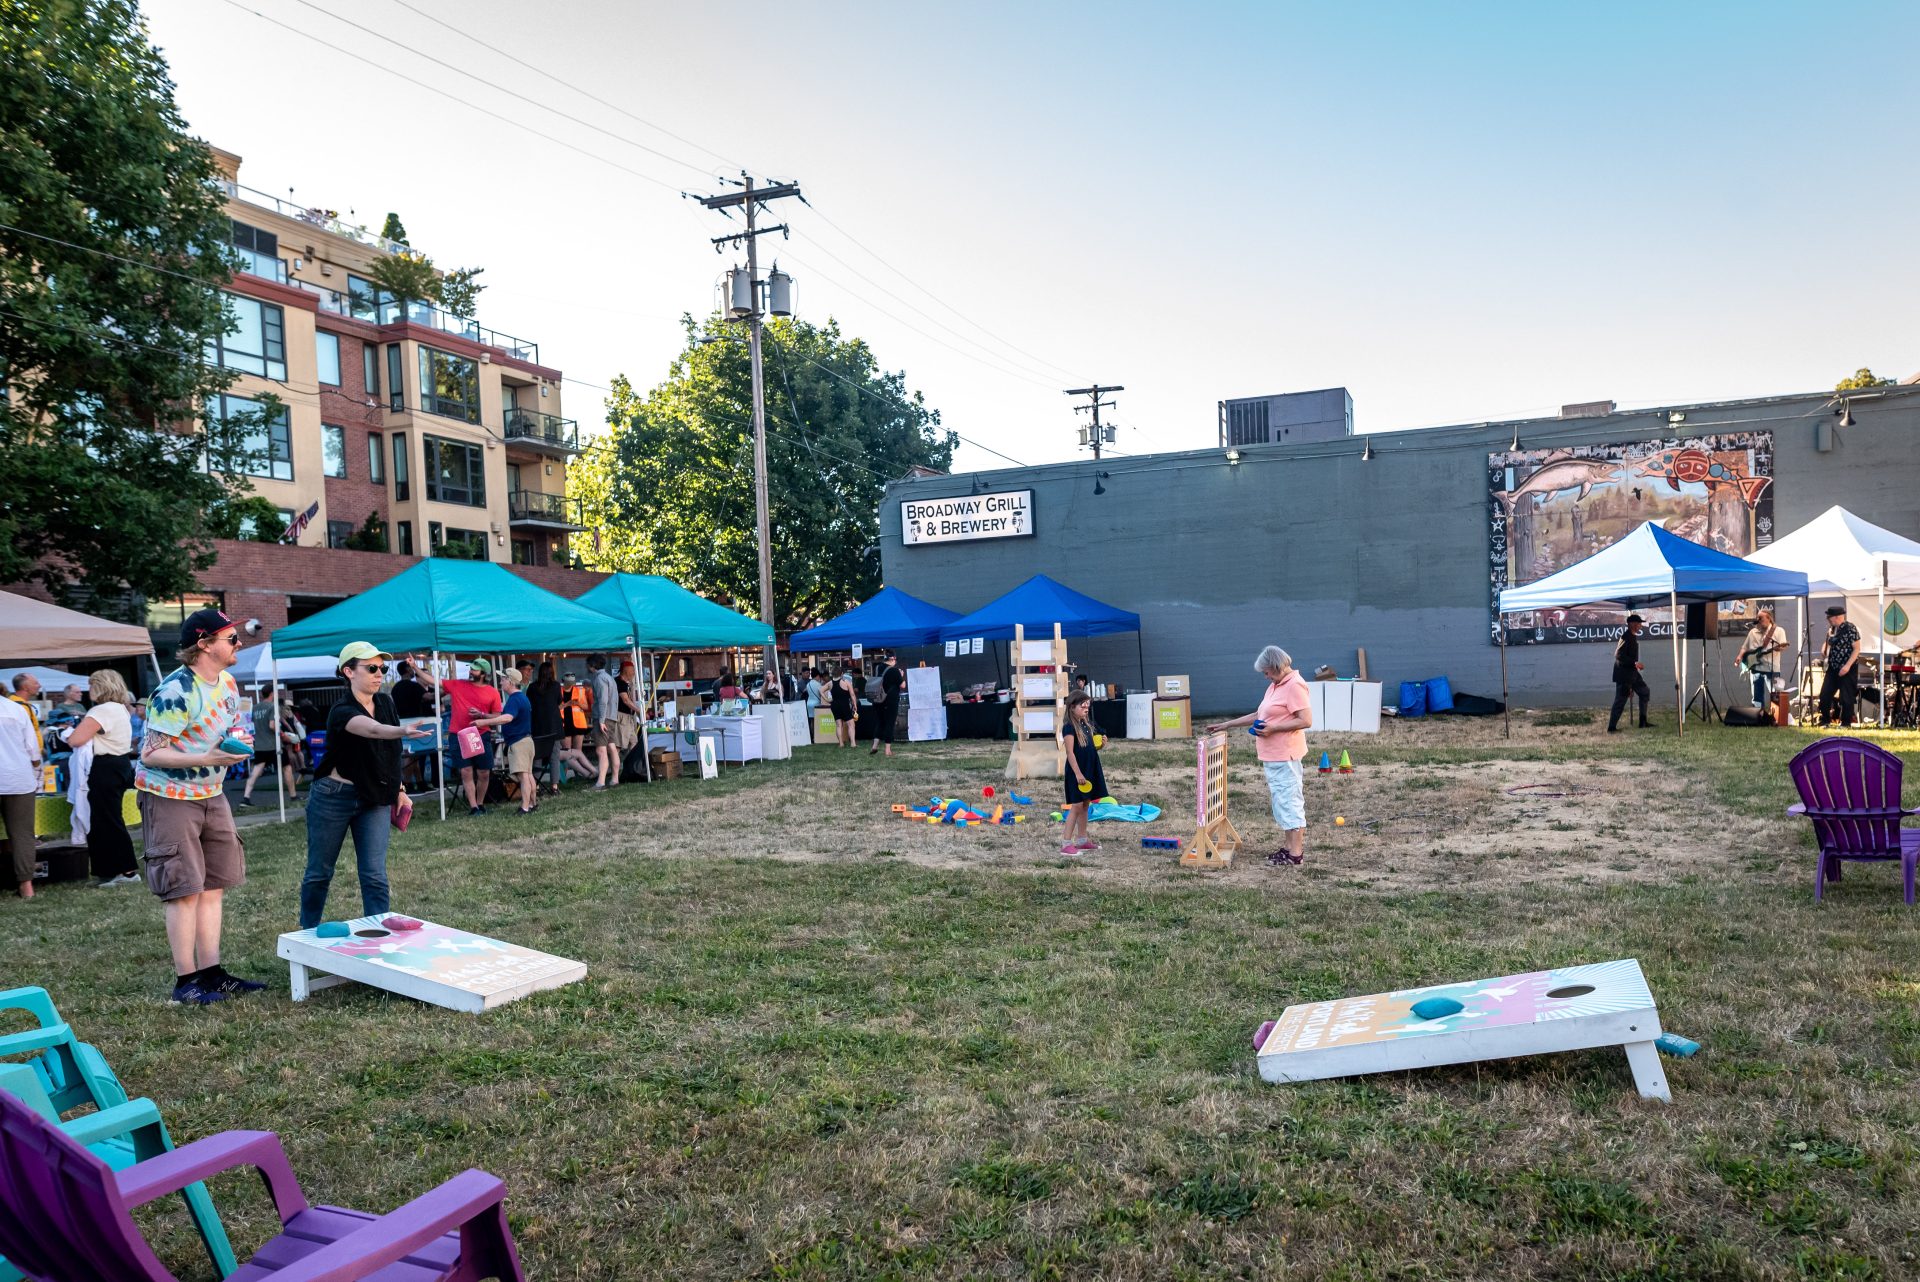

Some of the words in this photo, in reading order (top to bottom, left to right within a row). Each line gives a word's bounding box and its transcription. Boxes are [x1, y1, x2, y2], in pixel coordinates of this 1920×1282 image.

[907, 501, 981, 519] BROADWAY
[986, 497, 1026, 512] GRILL
[926, 522, 936, 536] &
[941, 518, 1007, 535] BREWERY
[1566, 626, 1643, 639] SULLIVAS
[1649, 623, 1685, 635] GULC
[1294, 1001, 1337, 1049] PORTLAND
